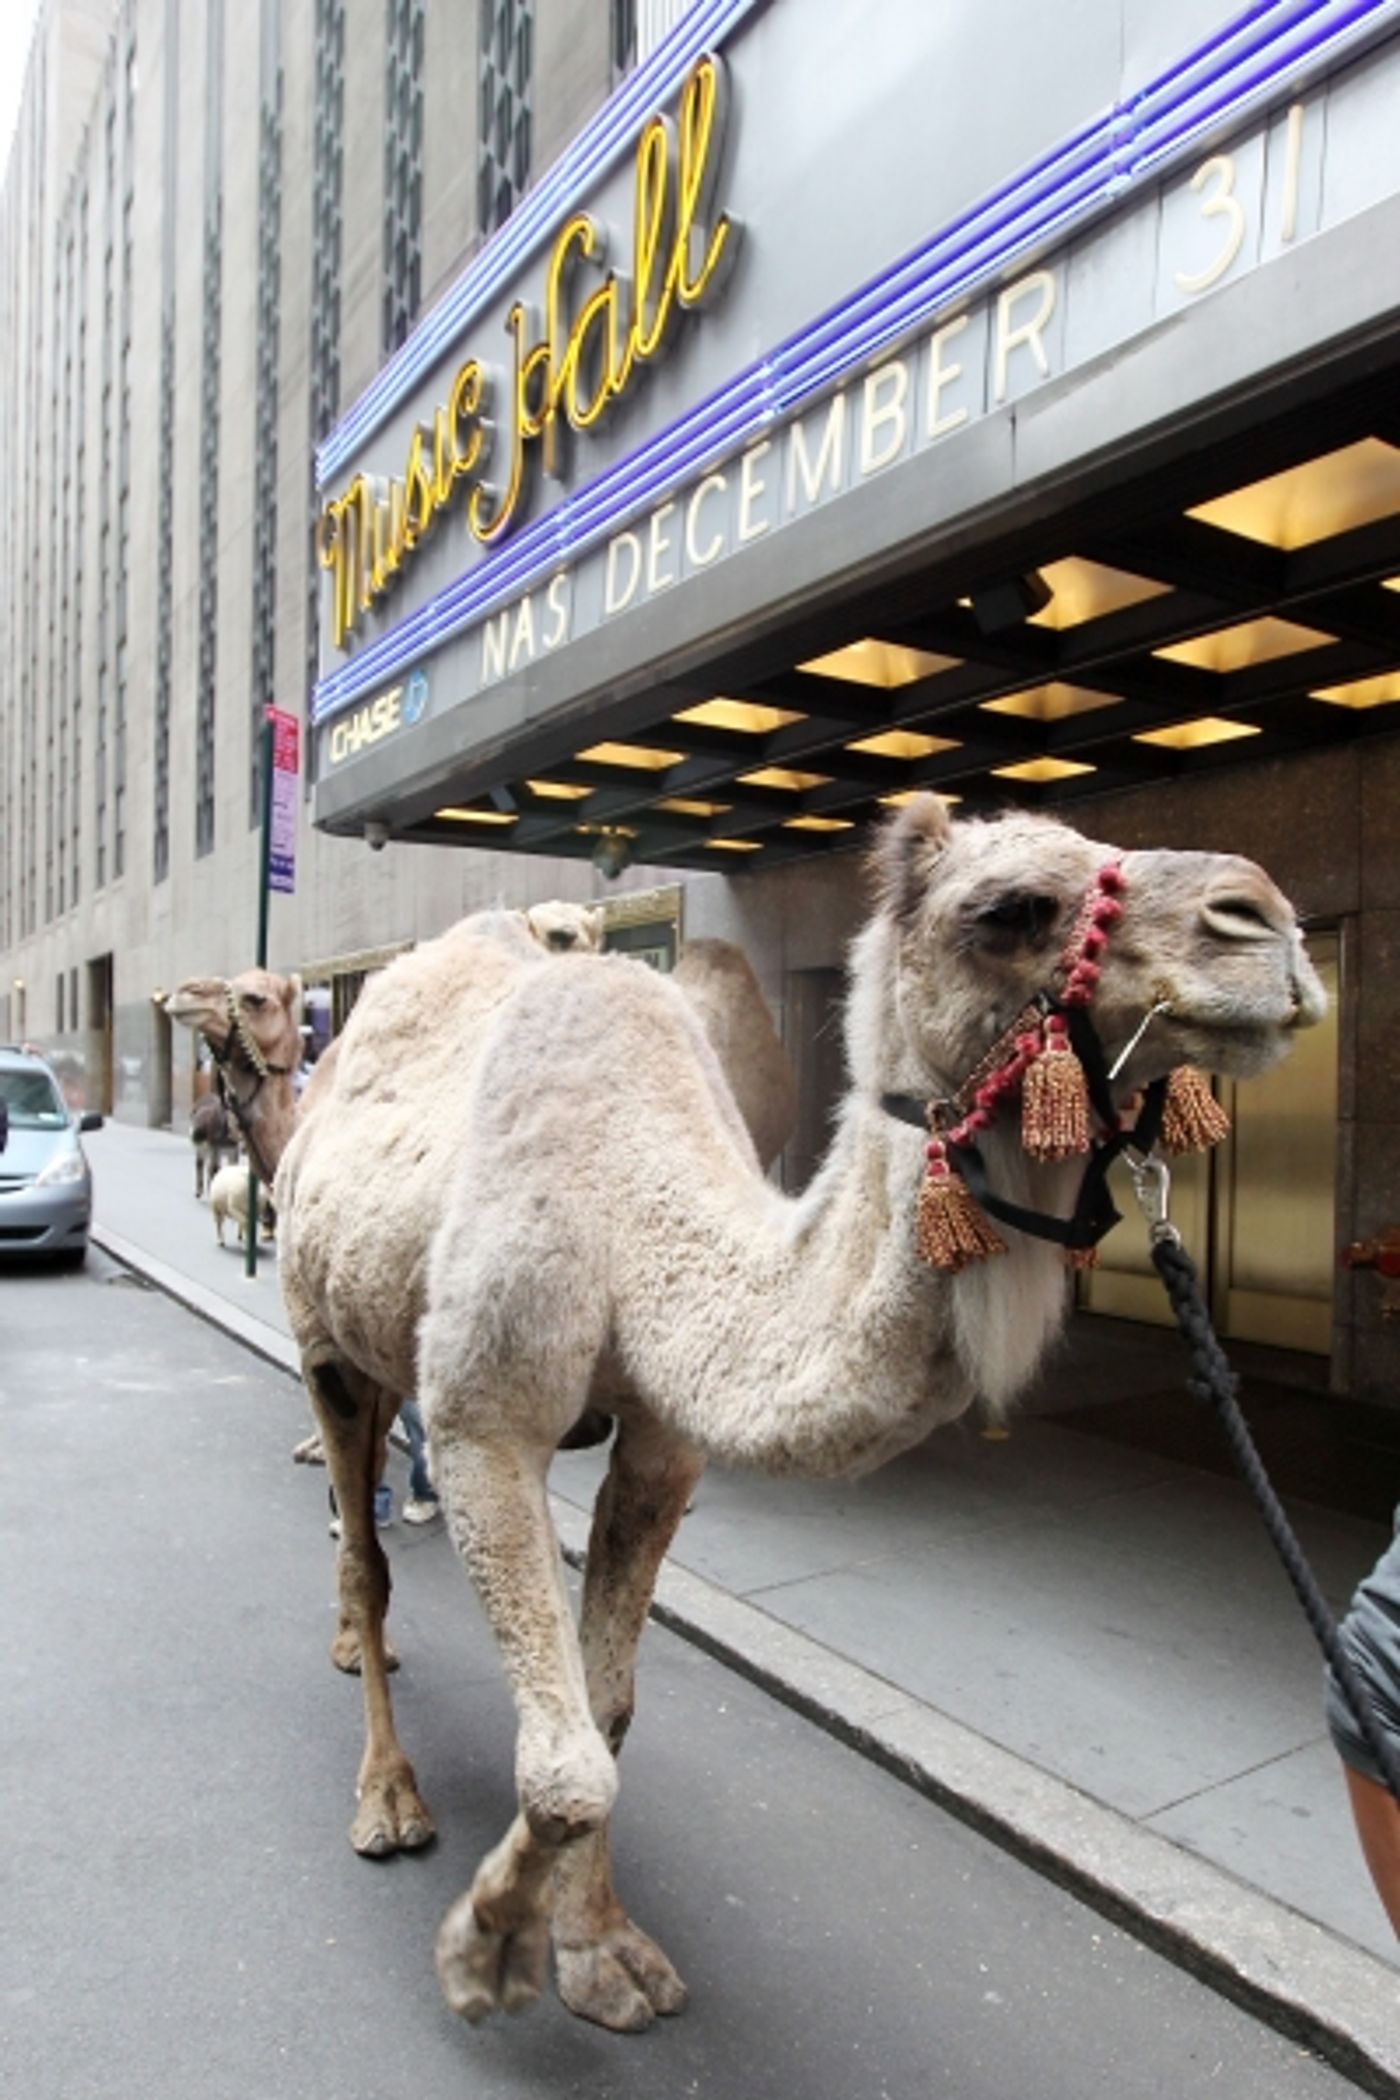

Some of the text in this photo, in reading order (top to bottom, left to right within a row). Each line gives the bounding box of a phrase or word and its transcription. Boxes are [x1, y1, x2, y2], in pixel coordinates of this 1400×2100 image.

[318, 52, 738, 649] Music Hall
[480, 103, 1304, 689] NAS DECEMBER 31
[329, 685, 403, 763] CHASE
